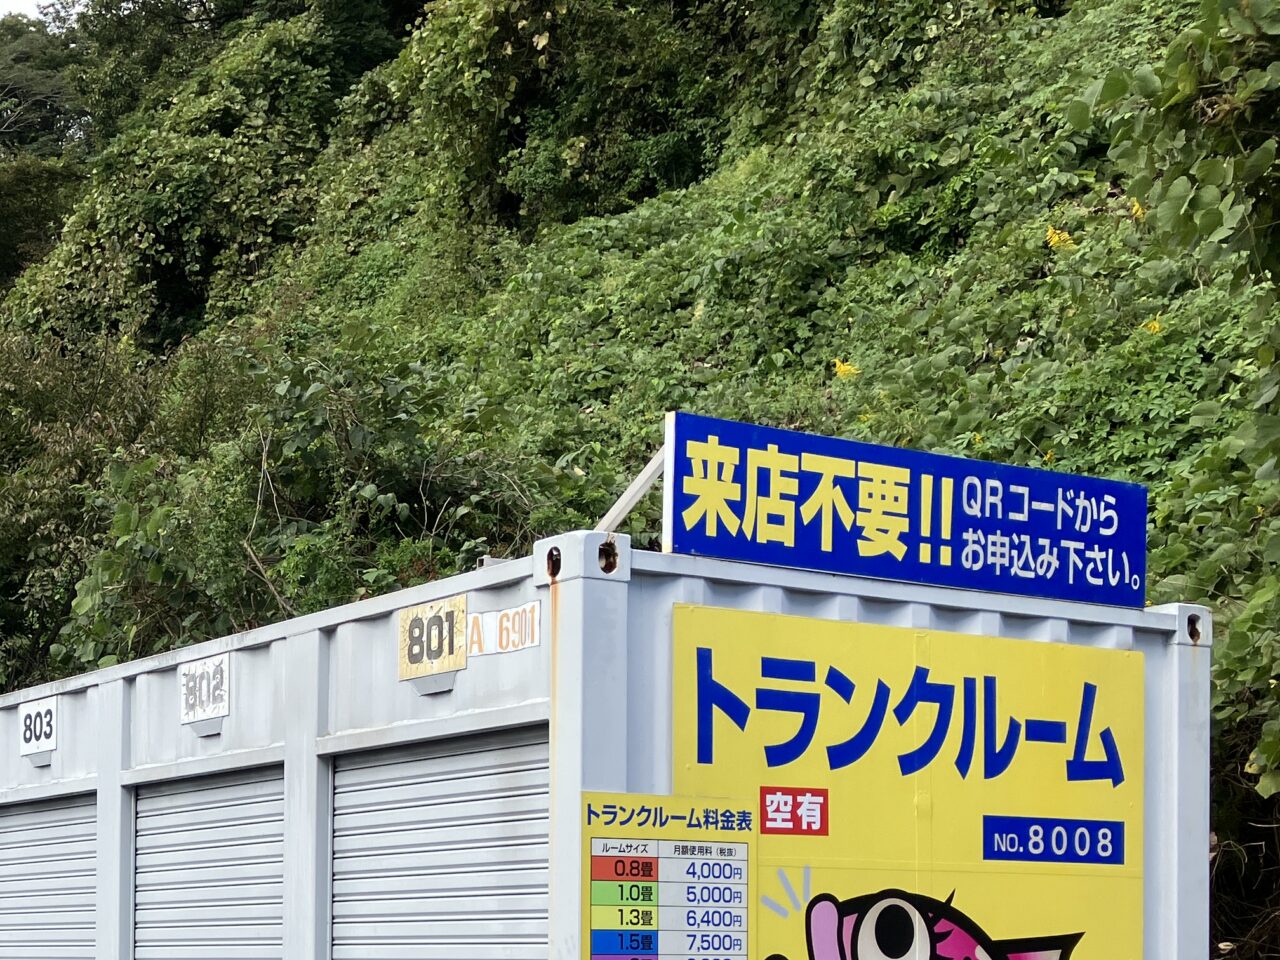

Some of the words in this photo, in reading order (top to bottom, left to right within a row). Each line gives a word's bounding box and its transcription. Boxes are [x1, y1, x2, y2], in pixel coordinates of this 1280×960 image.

[681, 434, 954, 566] 来店不要!!
[961, 475, 1119, 536] QRコードから
[961, 530, 1140, 591] お申込み下さい。
[407, 609, 455, 665] 801
[184, 664, 225, 713] 802
[22, 708, 54, 745] 803
[696, 646, 1125, 788] トランクルーム
[587, 803, 753, 832] トランクルーム料金表
[765, 791, 824, 831] 空有
[601, 842, 649, 854] ルームサイズ
[614, 860, 653, 878] 0.8畳
[685, 861, 742, 880] 4,000円
[618, 884, 653, 902] 1.0畳
[686, 886, 742, 904] 5,000円
[618, 908, 653, 926] 1.3畳
[686, 910, 742, 928] 6,400円
[618, 933, 653, 951] 1.5畳
[686, 934, 742, 952] 7,500円
